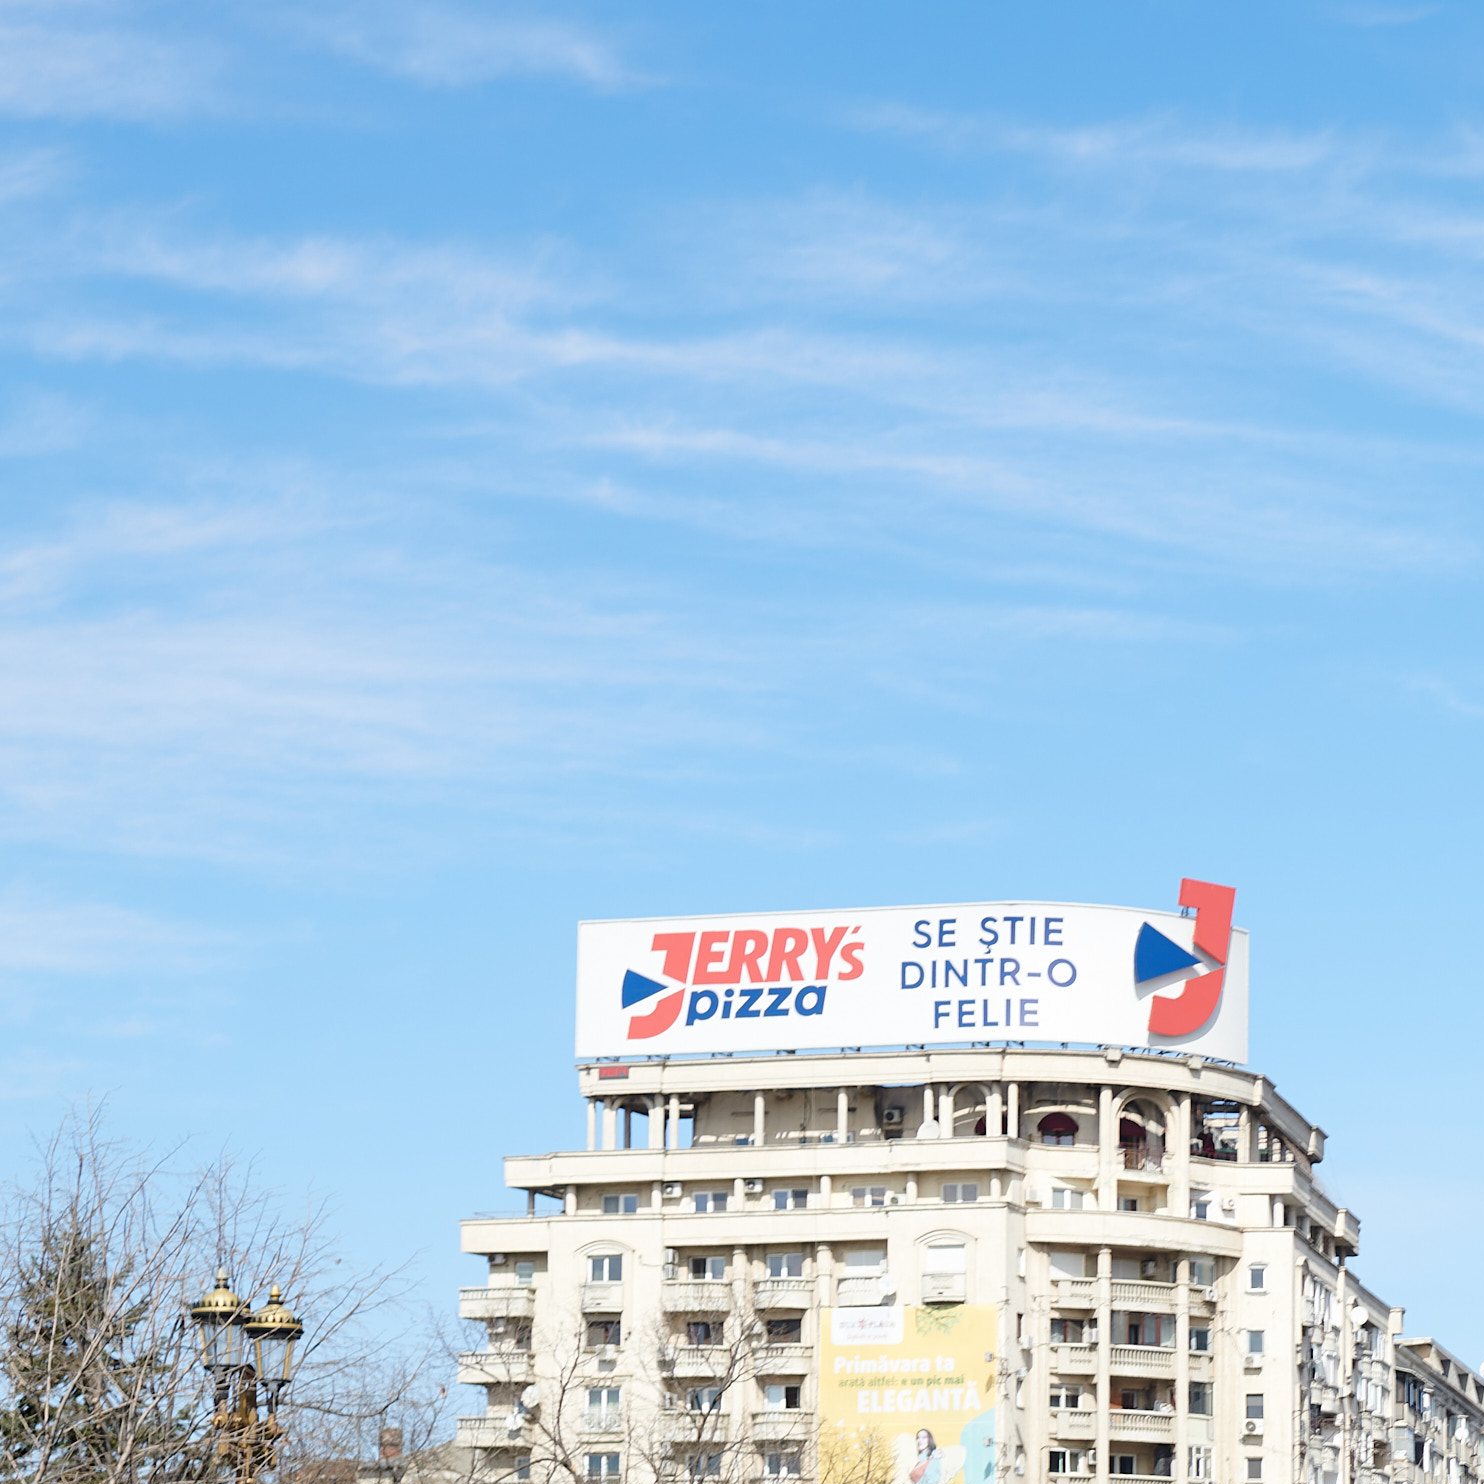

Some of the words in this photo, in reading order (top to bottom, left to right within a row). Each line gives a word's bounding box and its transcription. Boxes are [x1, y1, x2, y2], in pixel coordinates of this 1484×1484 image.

[912, 918, 957, 948] SE
[901, 958, 1077, 990] DINTR-O
[685, 985, 828, 1026] pizza
[934, 998, 1039, 1029] FELIE
[833, 1355, 931, 1374] Primăvara
[935, 1355, 955, 1372] ta
[857, 1381, 982, 1413] ELEGANTĂ
